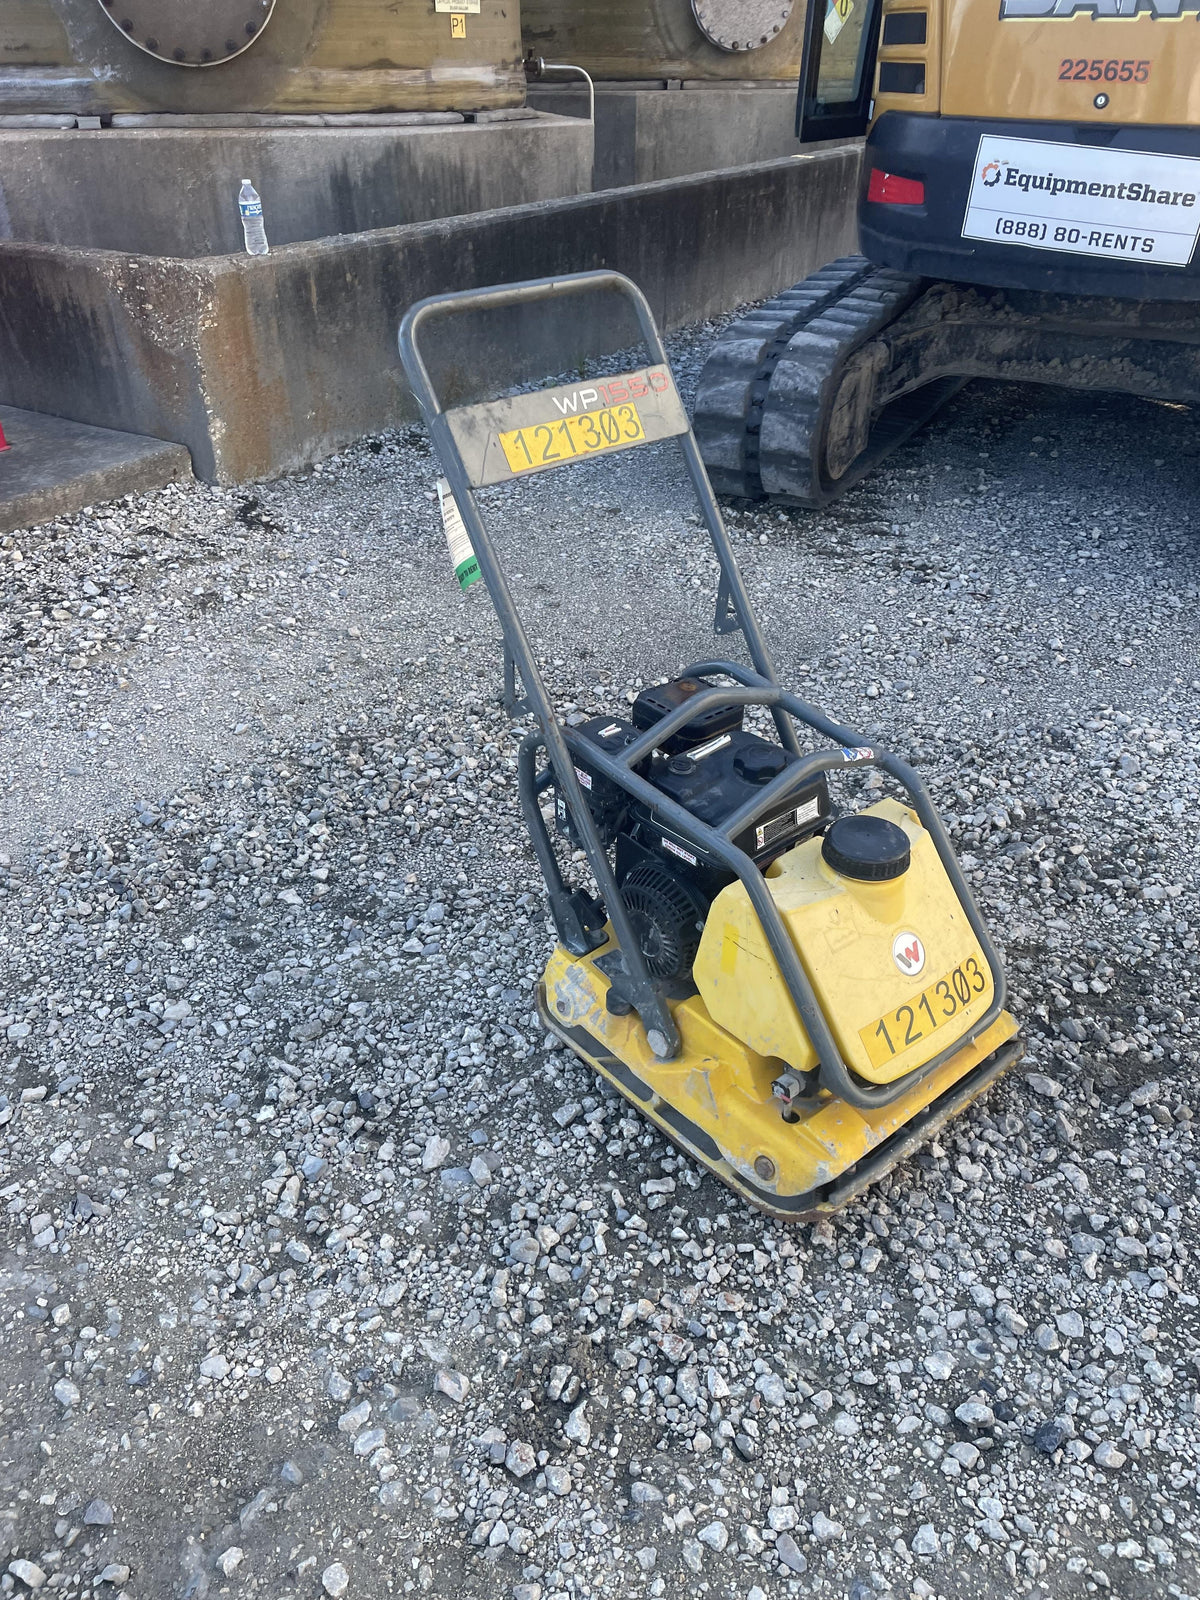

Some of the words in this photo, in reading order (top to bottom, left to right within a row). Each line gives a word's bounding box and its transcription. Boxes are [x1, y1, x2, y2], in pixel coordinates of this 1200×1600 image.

[451, 17, 464, 33] P1
[1058, 58, 1151, 82] 225655
[1003, 167, 1196, 208] EquipmentShare
[995, 217, 1048, 241] (888)
[1053, 226, 1155, 253] 80-RENTS
[551, 371, 670, 415] WP1550
[513, 405, 641, 465] 121303
[875, 957, 986, 1055] 121303
